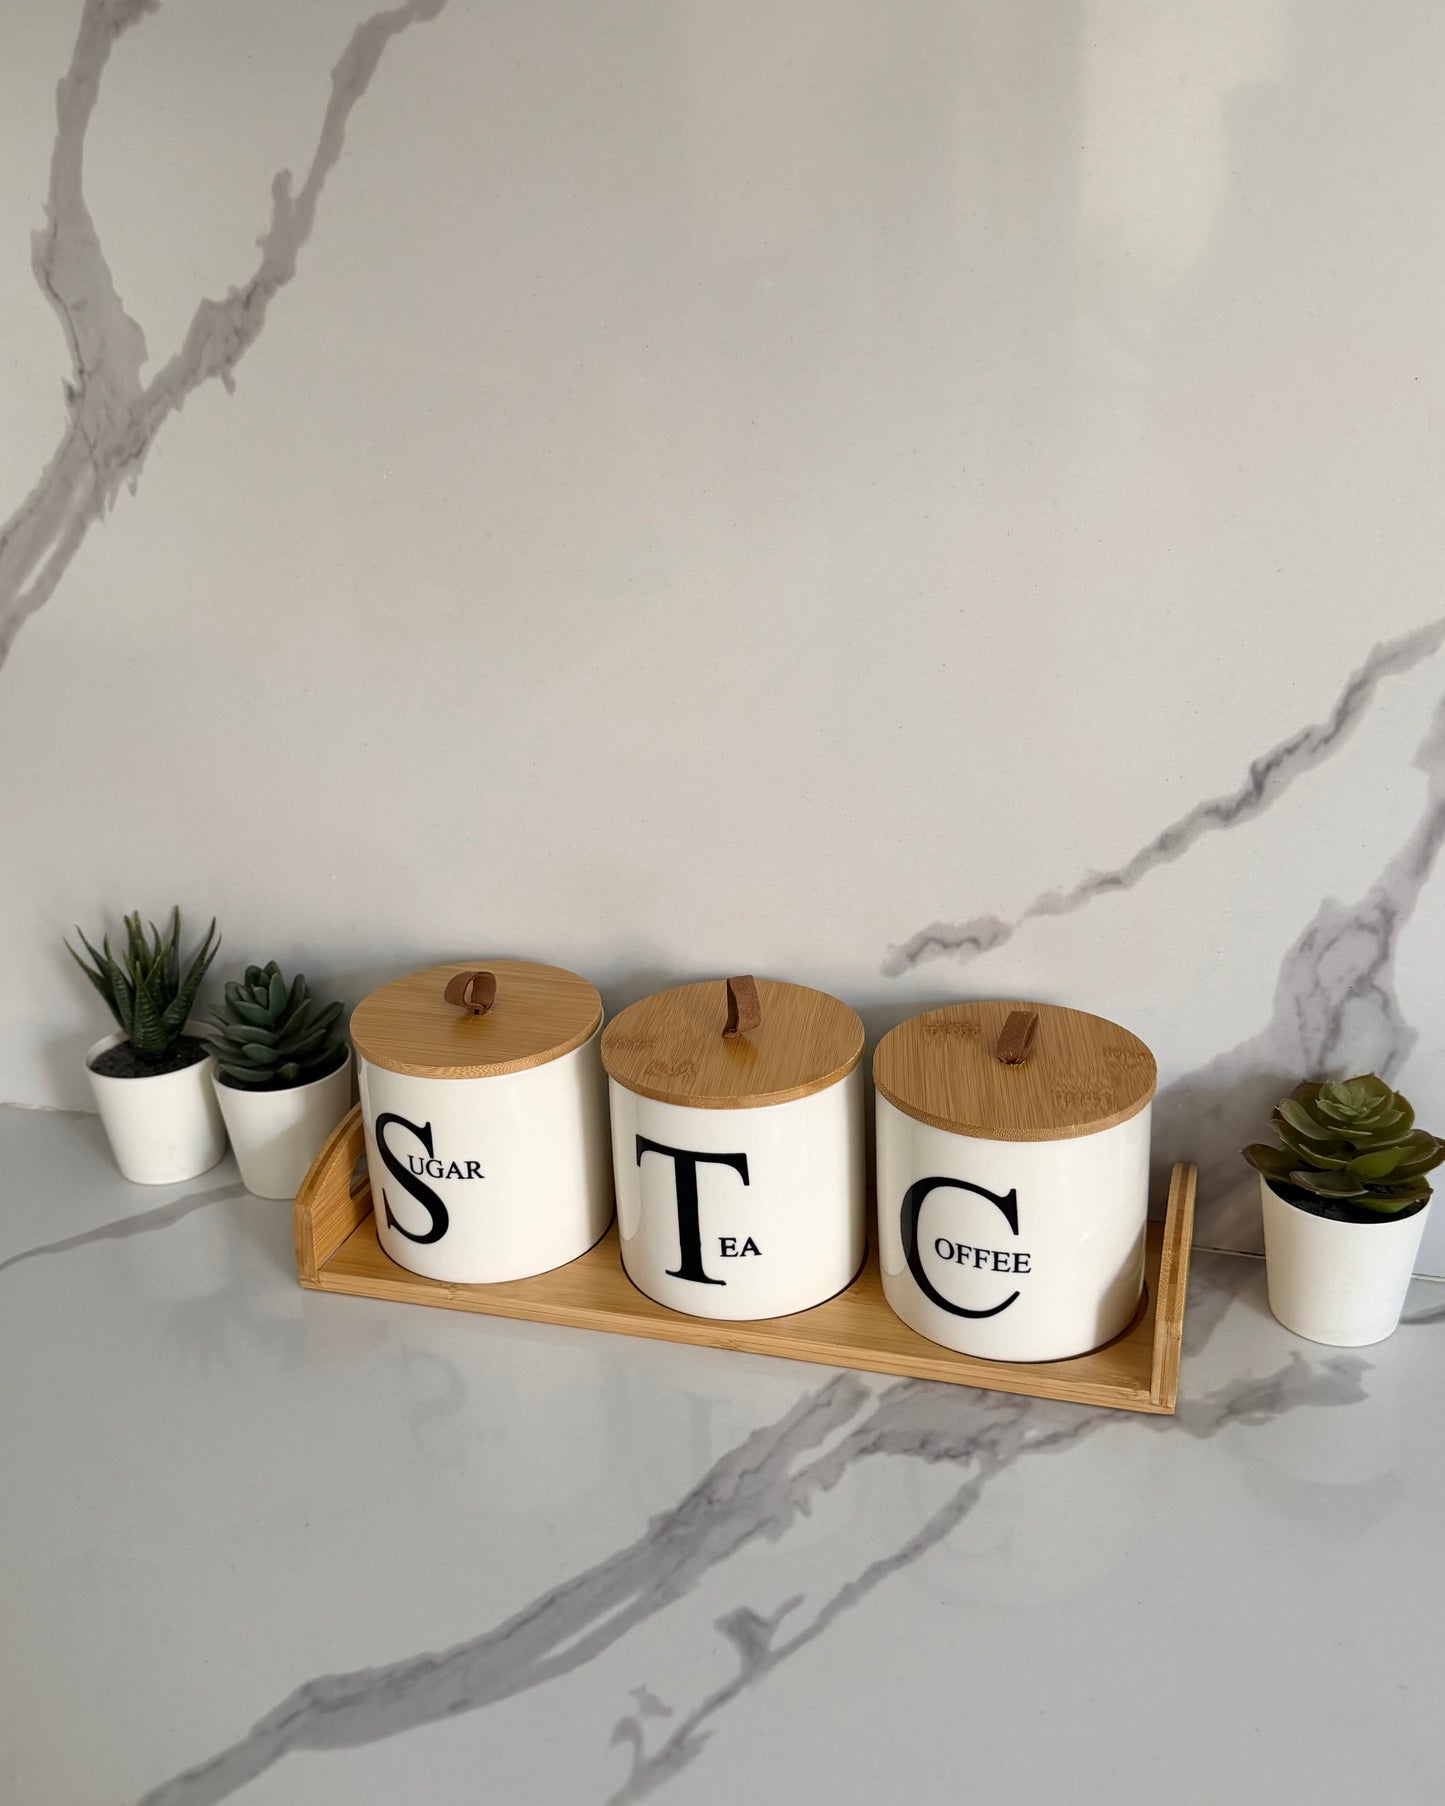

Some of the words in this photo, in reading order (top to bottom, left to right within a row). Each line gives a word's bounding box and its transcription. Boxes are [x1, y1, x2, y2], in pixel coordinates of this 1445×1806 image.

[375, 1112, 485, 1245] SUGAR
[636, 1133, 762, 1286] TEA
[900, 1176, 1032, 1319] COFFEE
